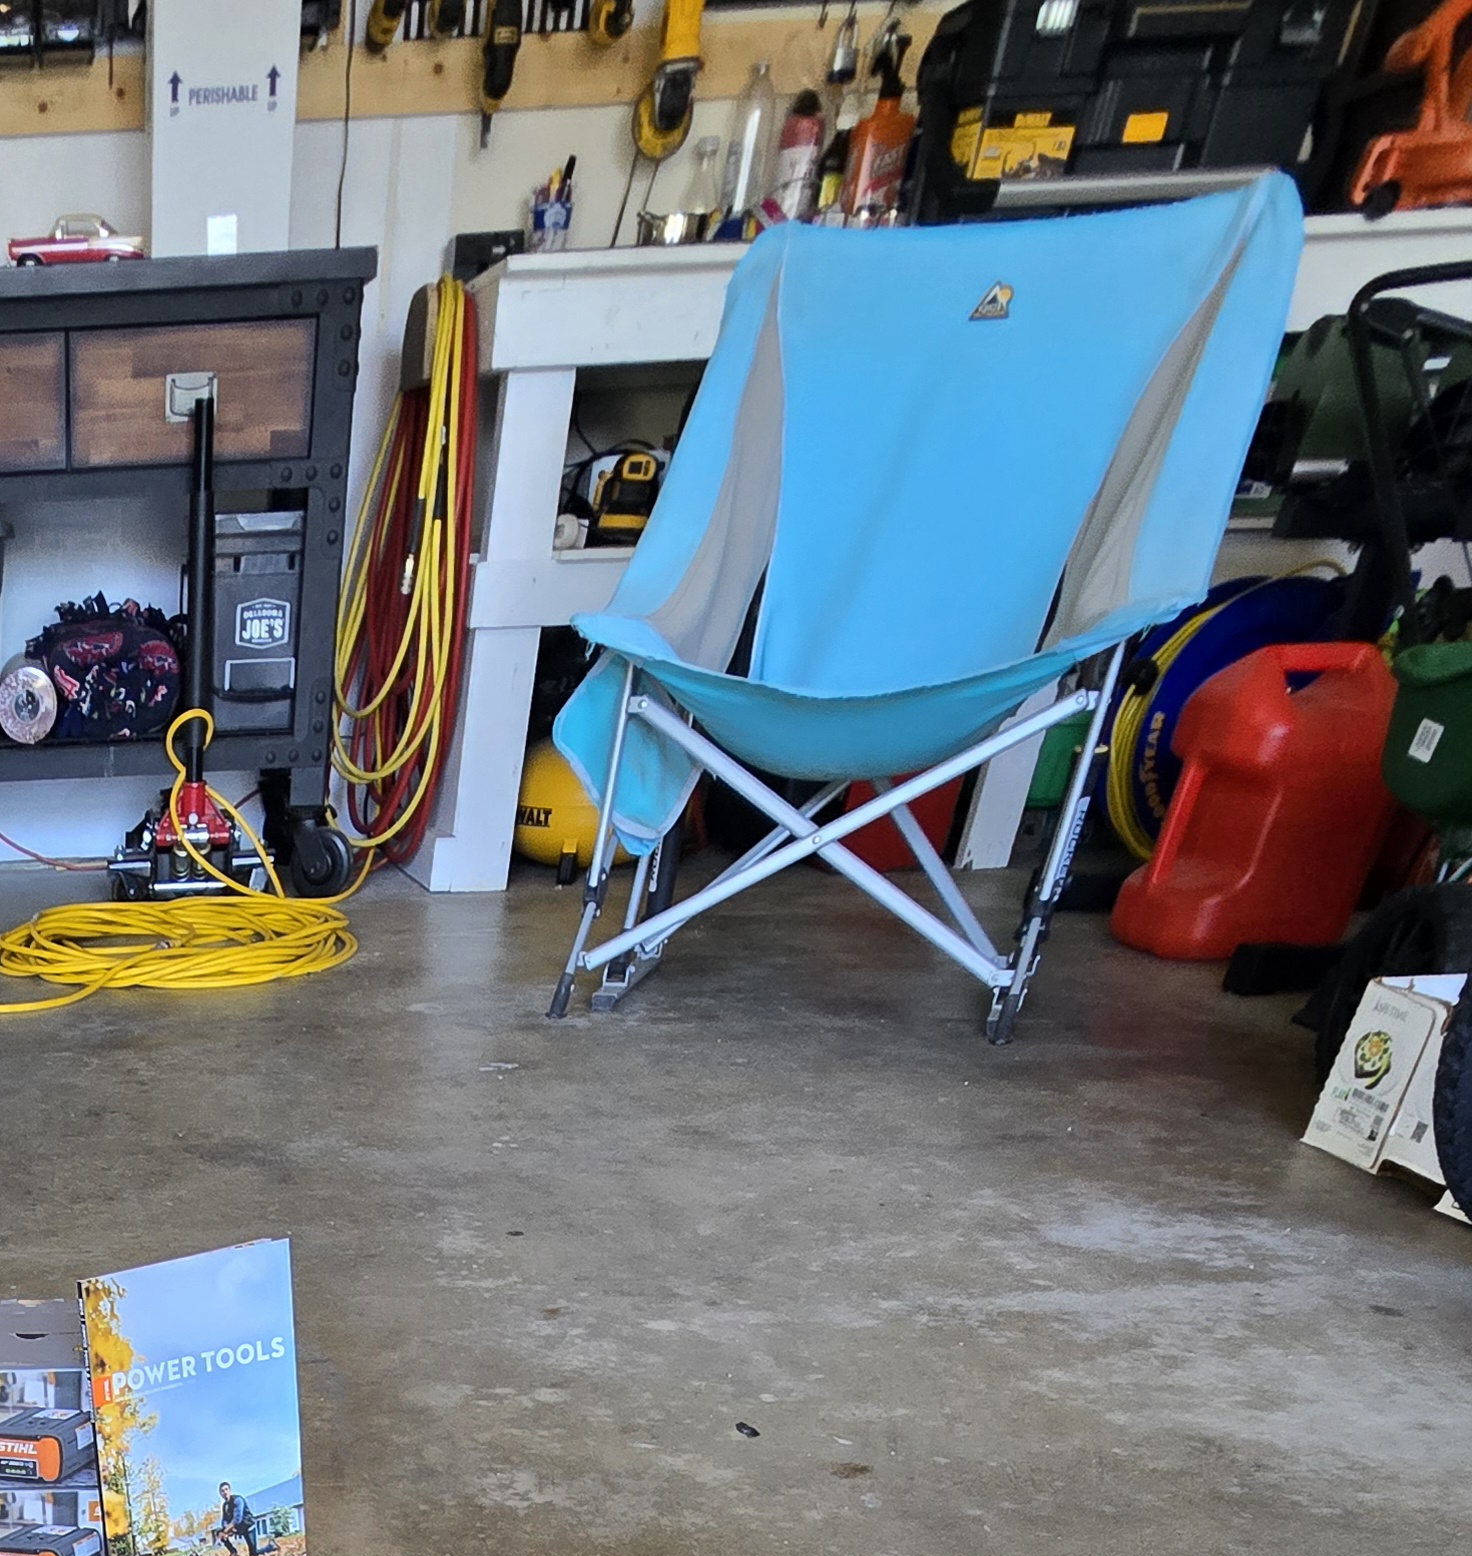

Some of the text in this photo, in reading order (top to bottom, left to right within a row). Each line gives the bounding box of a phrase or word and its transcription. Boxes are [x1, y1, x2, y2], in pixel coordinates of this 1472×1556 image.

[188, 84, 258, 106] PERISHABLE
[241, 618, 284, 640] JOE'S
[111, 1354, 197, 1396] POWER
[200, 1336, 286, 1373] TOOLS
